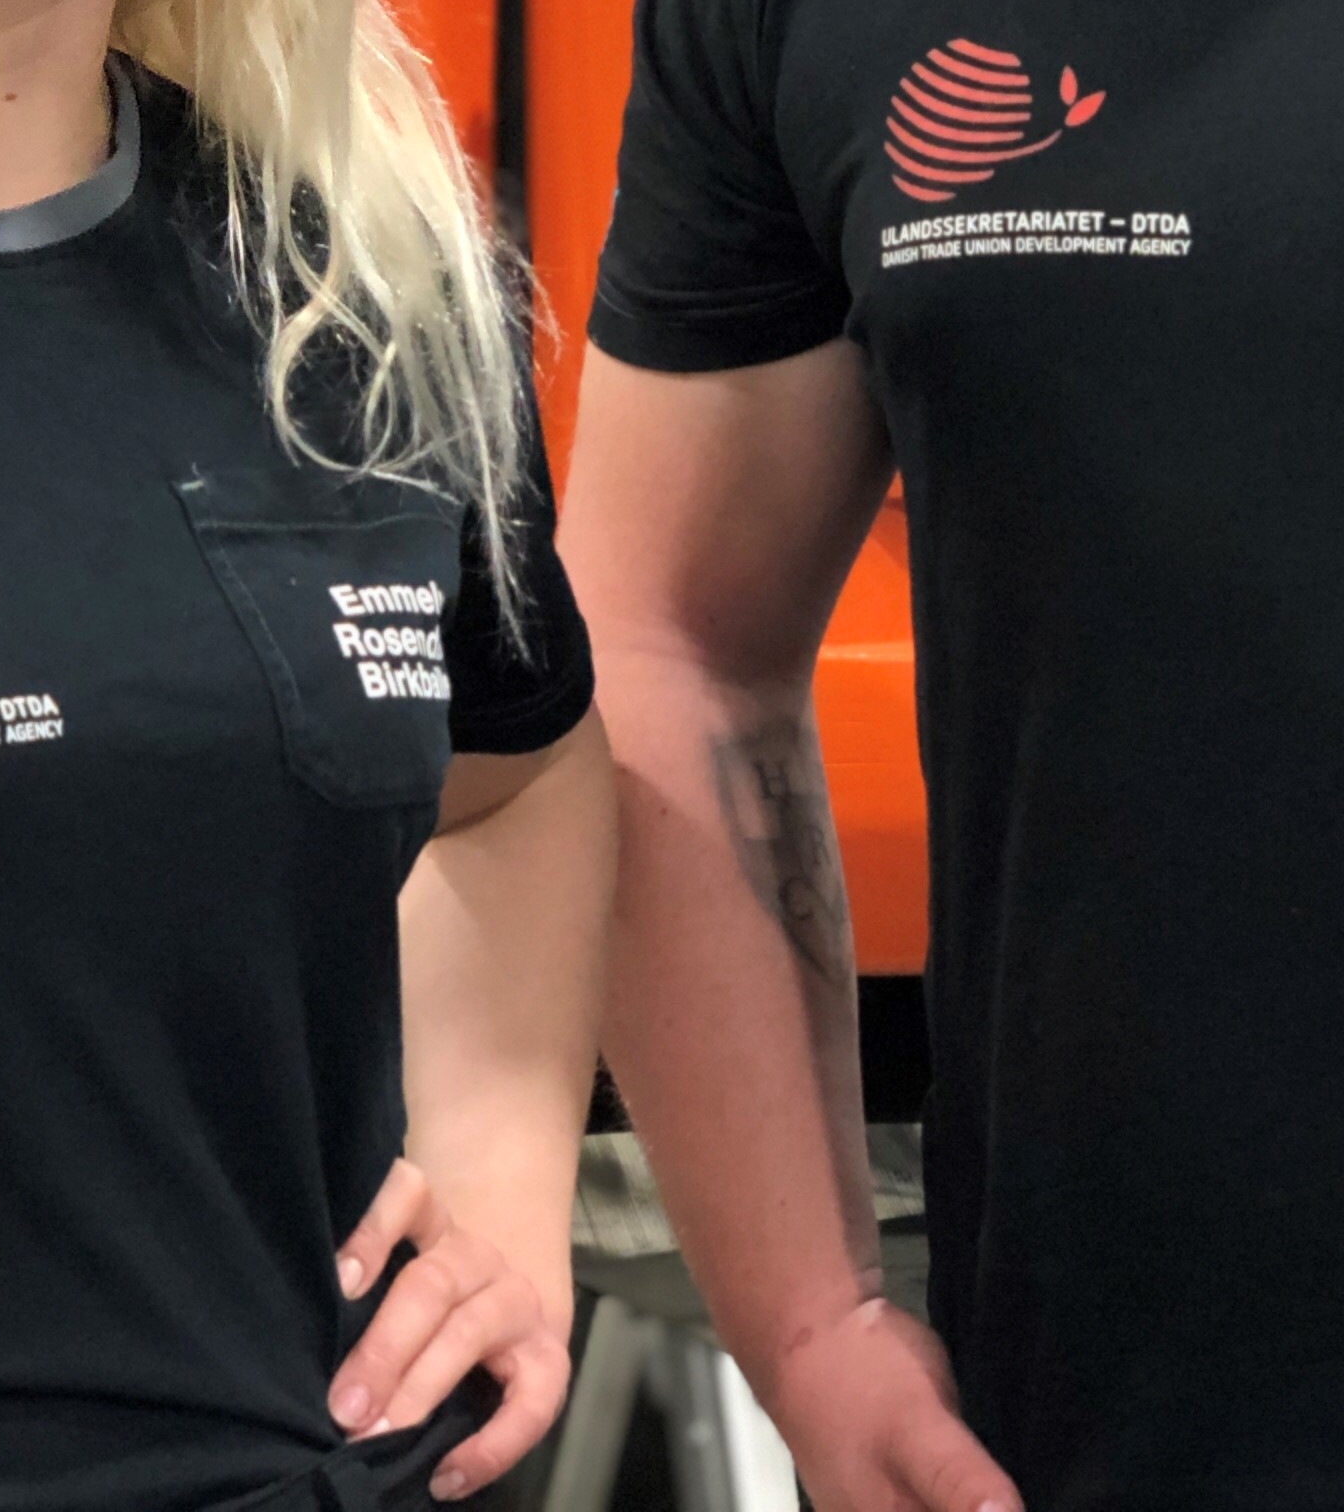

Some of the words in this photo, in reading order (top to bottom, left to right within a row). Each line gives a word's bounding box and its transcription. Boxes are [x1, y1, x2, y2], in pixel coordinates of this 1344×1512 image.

[881, 210, 1105, 248] ULANDSSEKRETARIATET
[1131, 212, 1191, 235] DTDA
[881, 246, 919, 269] DANISH
[920, 241, 962, 261] TRADE
[964, 238, 1013, 256] UNION
[1015, 237, 1127, 255] DEVELOPMENT
[1129, 239, 1192, 256] AGENCY
[5, 718, 65, 743] AGENCY
